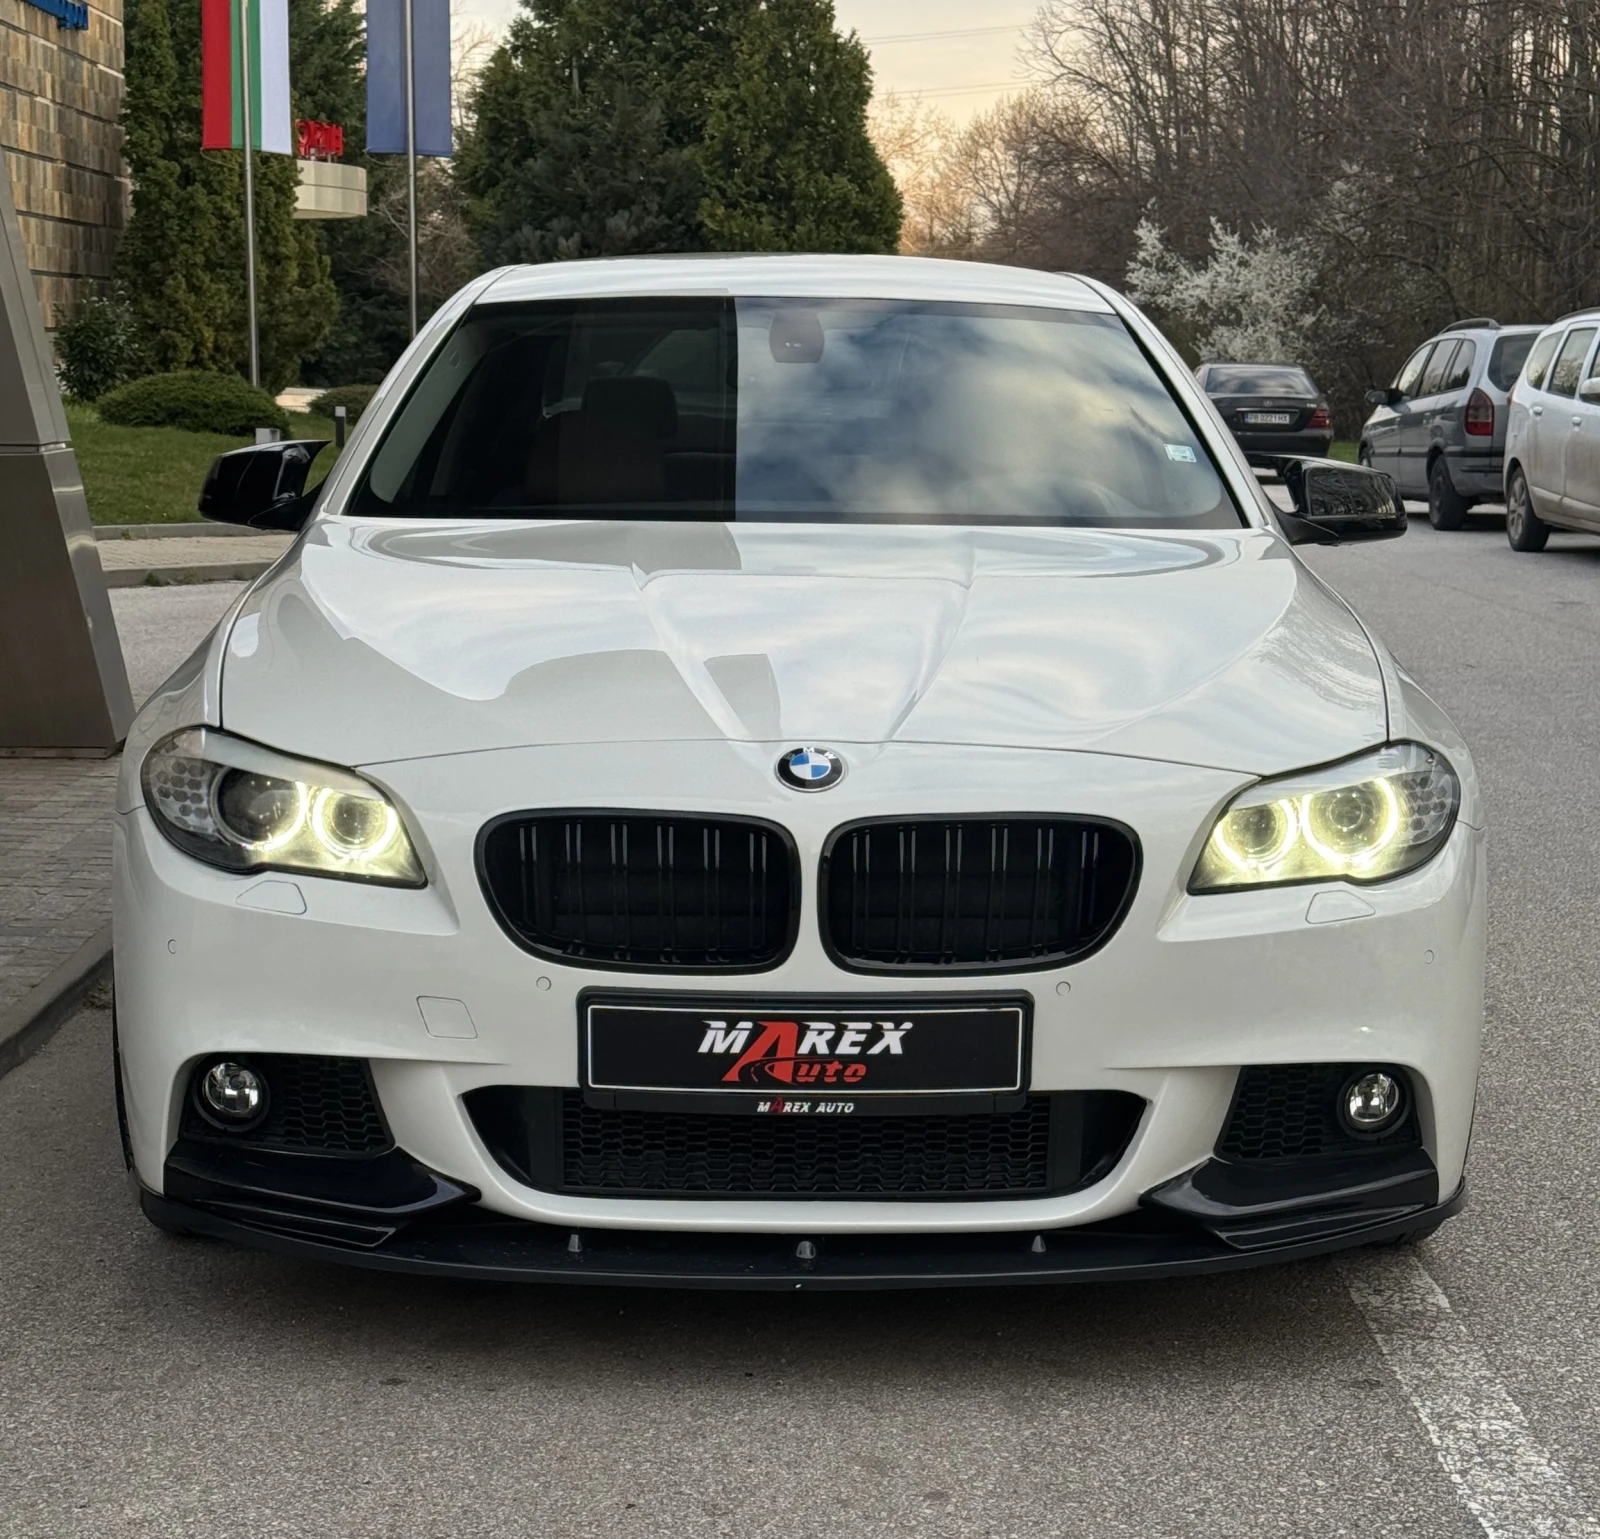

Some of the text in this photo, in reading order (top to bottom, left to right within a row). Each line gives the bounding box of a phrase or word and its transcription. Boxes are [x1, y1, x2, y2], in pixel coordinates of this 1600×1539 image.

[782, 747, 837, 760] BMW
[698, 1020, 913, 1084] MAREX
[757, 1096, 854, 1114] MAREX AUTO
